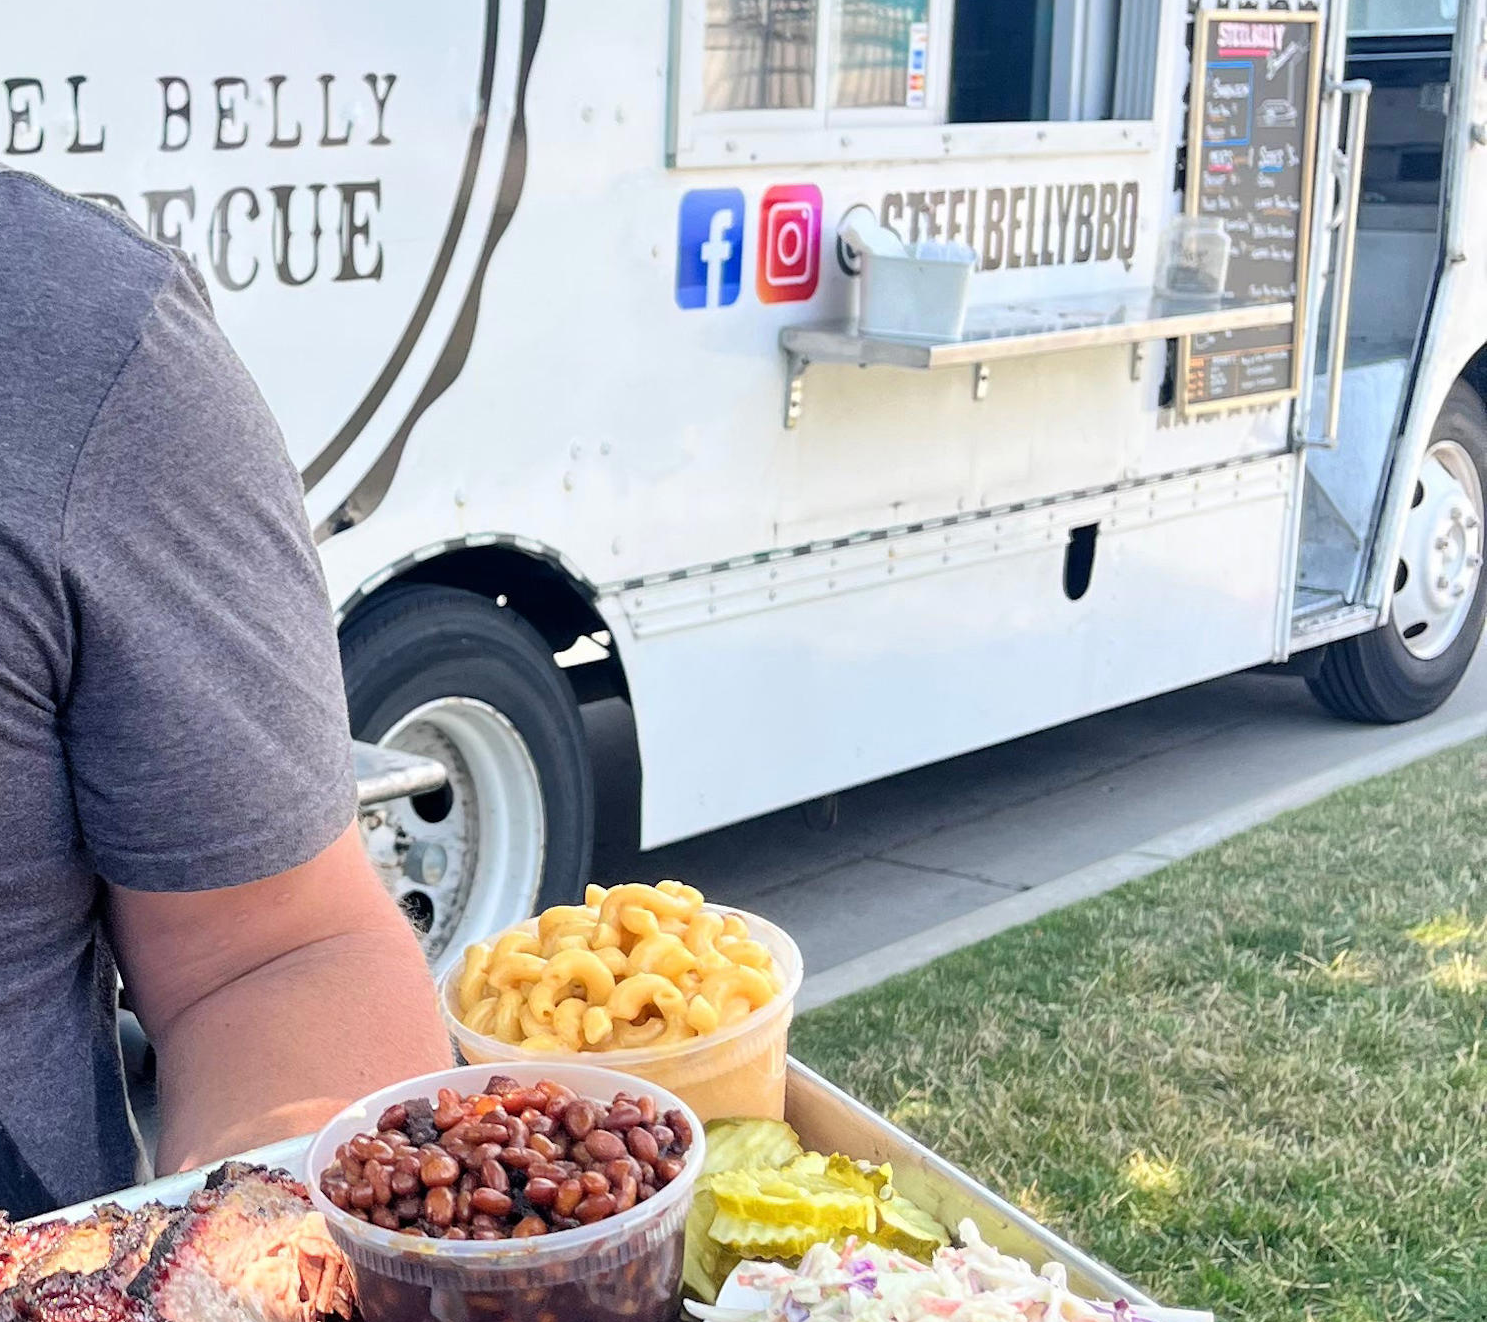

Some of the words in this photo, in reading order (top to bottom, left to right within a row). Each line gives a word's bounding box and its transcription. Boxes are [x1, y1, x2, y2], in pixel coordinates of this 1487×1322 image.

[158, 72, 397, 152] BELLY
[77, 180, 385, 292] ECUE
[837, 181, 1139, 276] STEELBELLYBBQ
